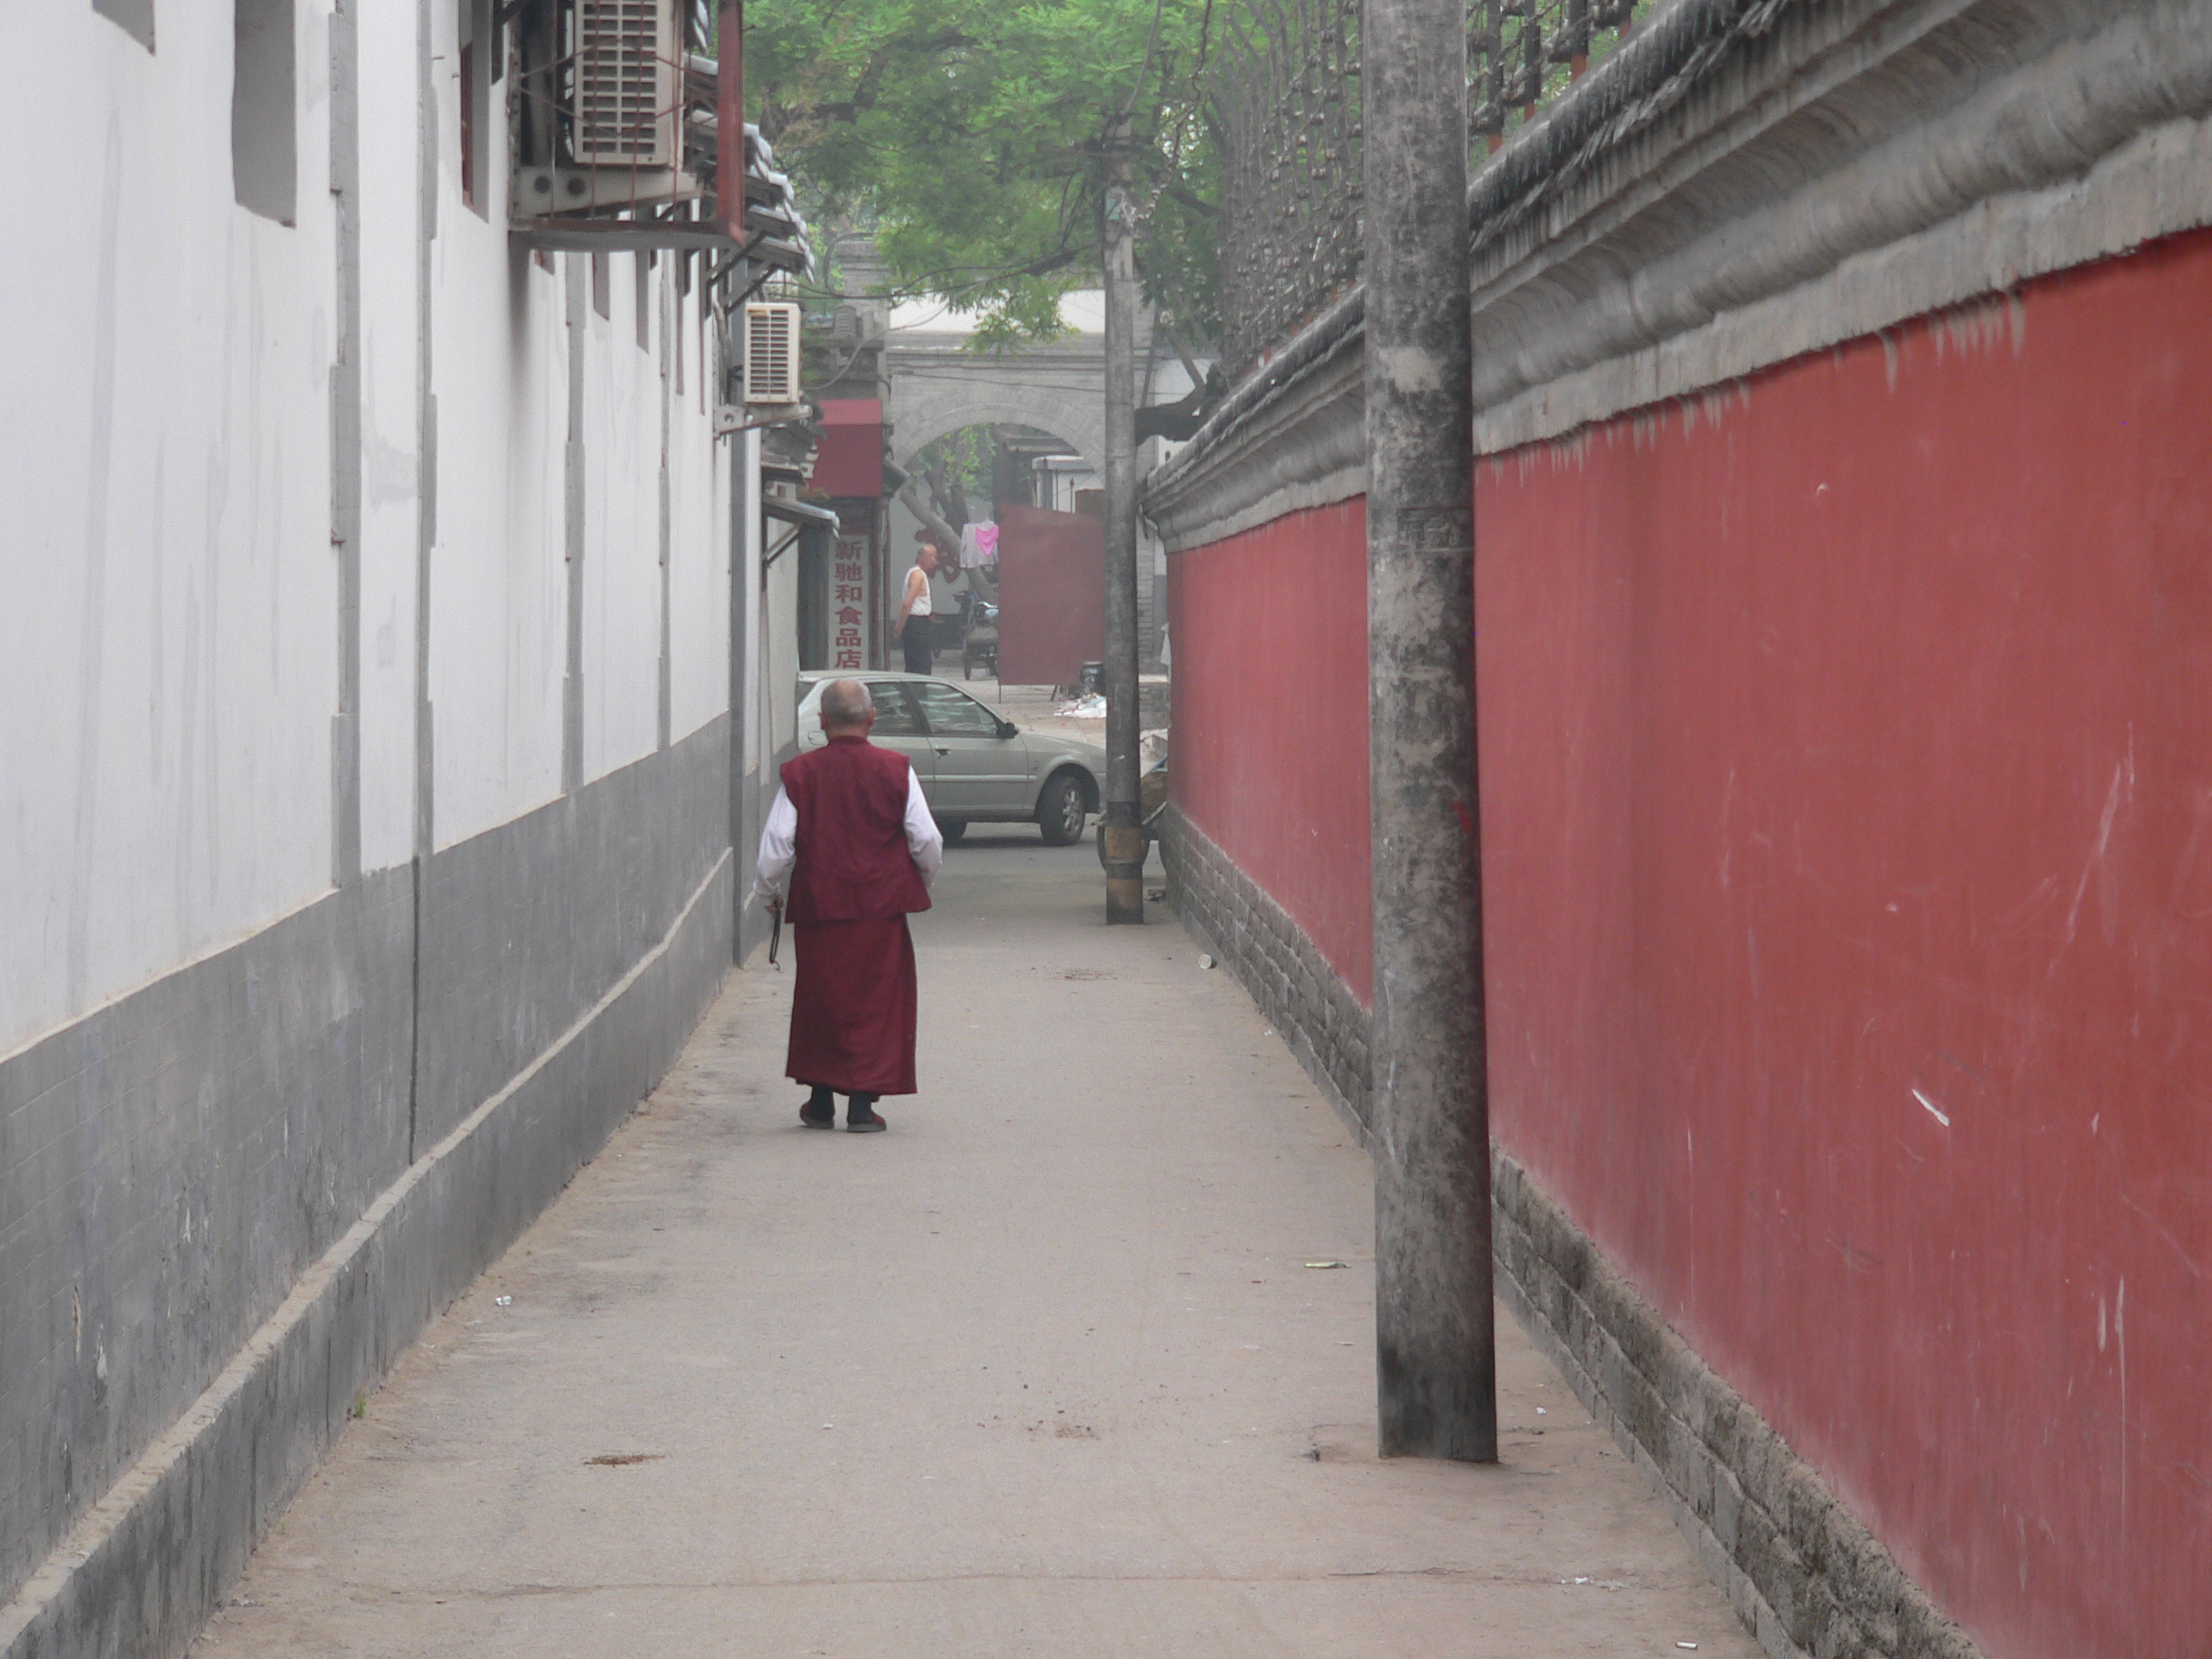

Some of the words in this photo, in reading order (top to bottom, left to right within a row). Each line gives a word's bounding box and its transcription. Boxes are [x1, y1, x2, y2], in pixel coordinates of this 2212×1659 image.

[834, 540, 864, 669] 新驰和食品店
